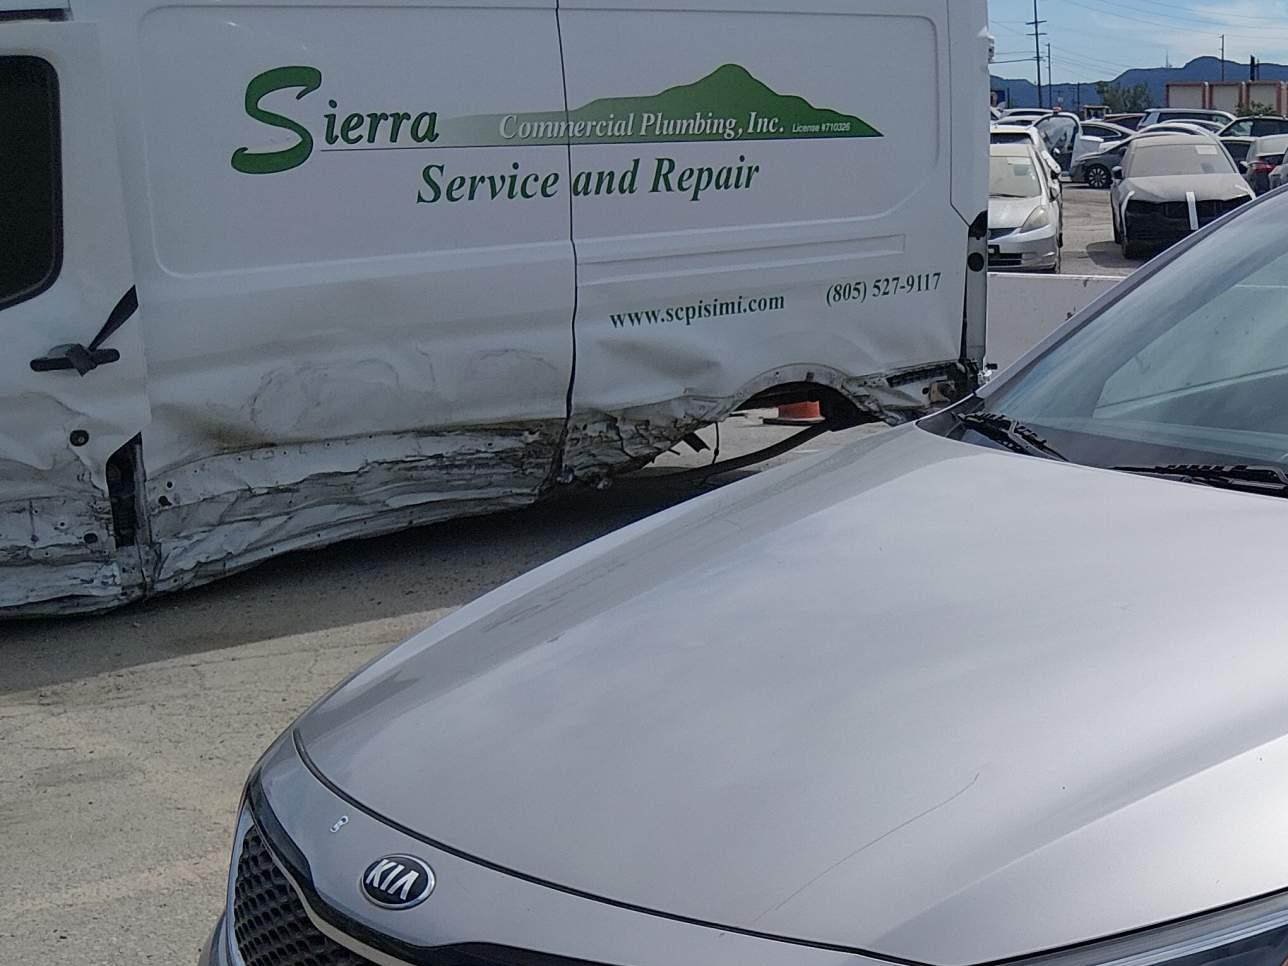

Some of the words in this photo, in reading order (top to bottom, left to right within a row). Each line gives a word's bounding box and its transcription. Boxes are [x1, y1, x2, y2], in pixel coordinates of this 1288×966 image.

[231, 66, 439, 174] Sierra
[499, 114, 632, 139] Commercial
[747, 111, 785, 134] Inc.
[416, 162, 559, 204] Service
[572, 158, 641, 197] and
[649, 155, 760, 202] Repair
[609, 295, 786, 330] www.scpisimi.com
[826, 280, 868, 307] (805)
[872, 272, 943, 300] 527-9117
[365, 859, 420, 901] KIA
